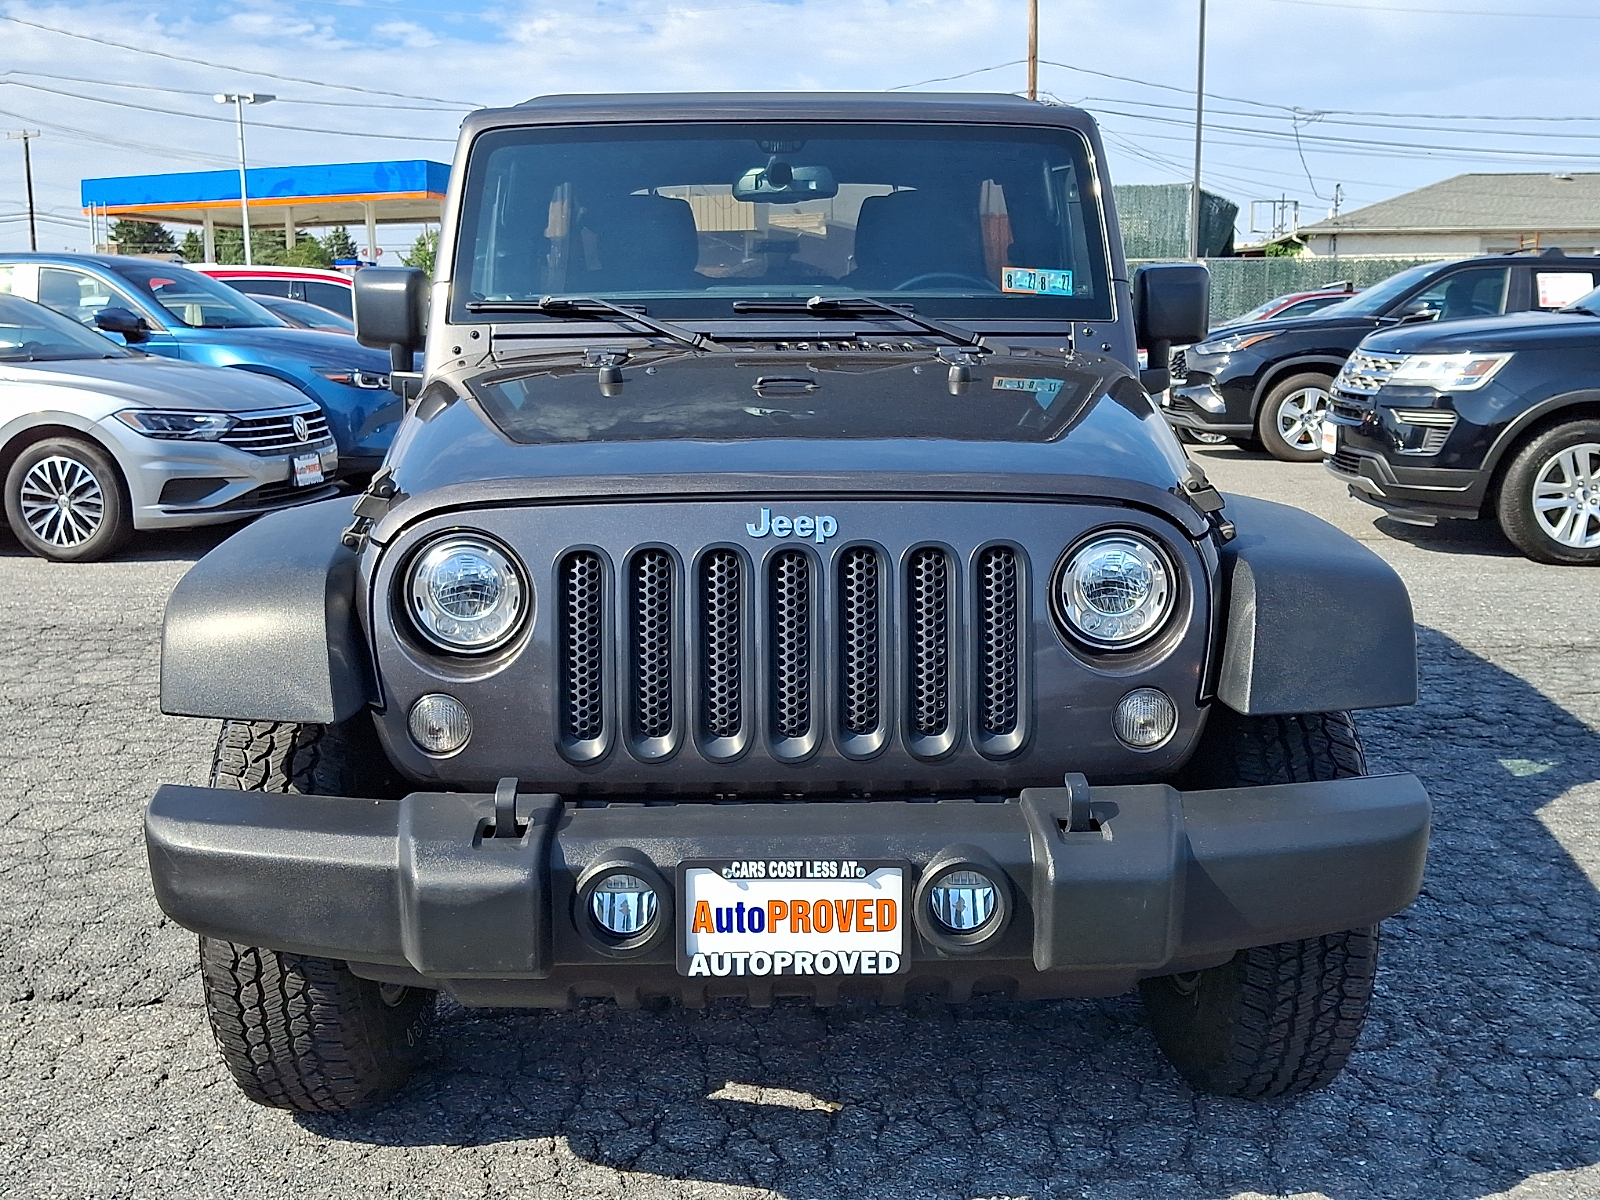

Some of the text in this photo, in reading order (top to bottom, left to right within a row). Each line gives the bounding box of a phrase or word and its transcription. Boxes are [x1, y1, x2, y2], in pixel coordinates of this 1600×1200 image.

[746, 507, 838, 544] Jeep
[731, 861, 858, 878] CARS COST LESS AT
[692, 899, 898, 933] AutoPROVED
[688, 951, 900, 976] AUTOPROVED
